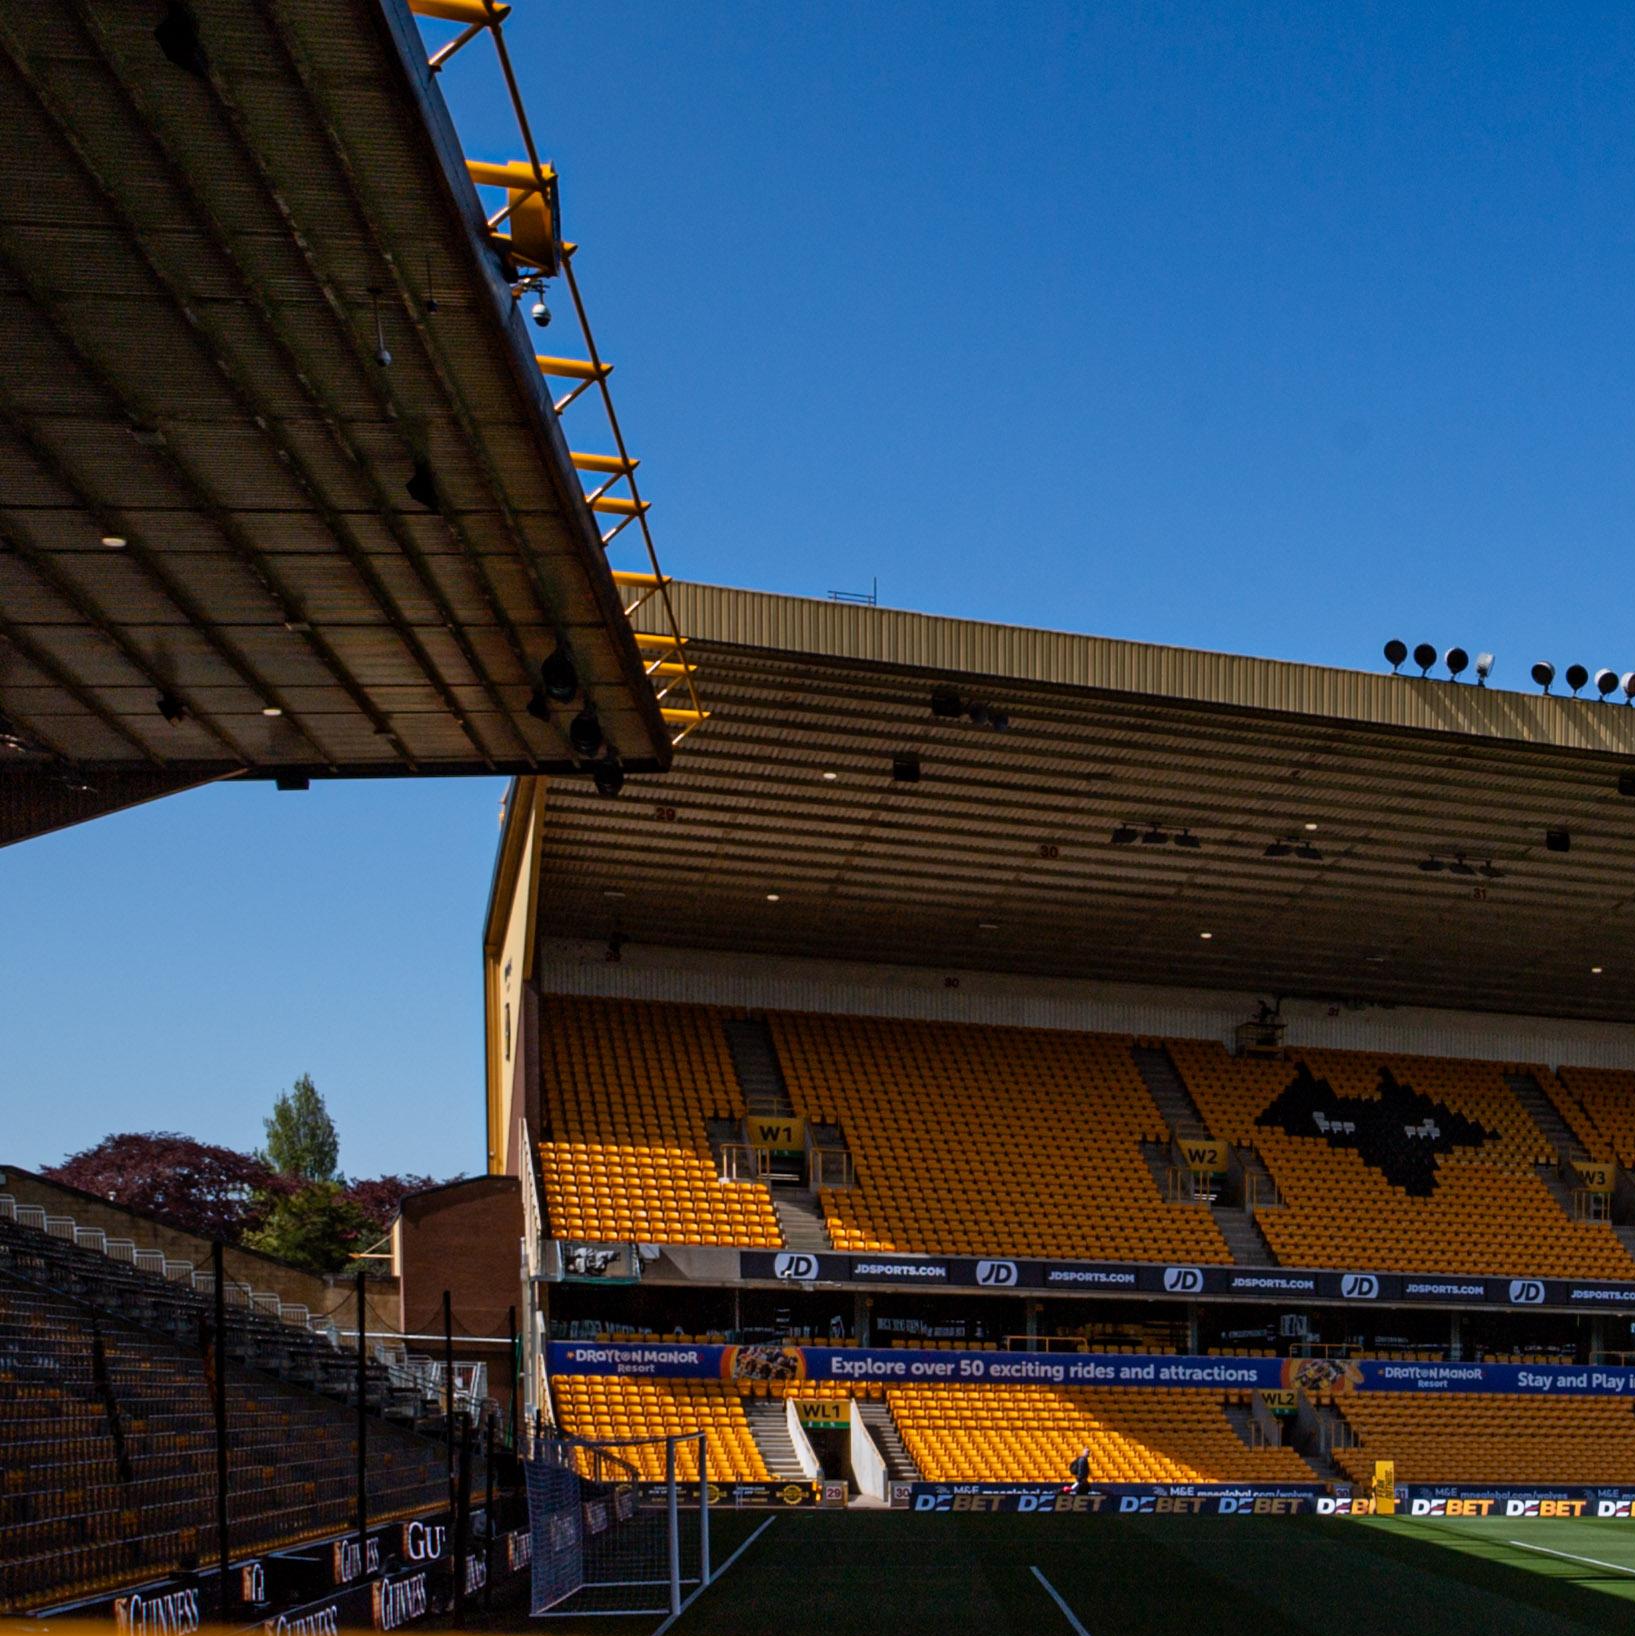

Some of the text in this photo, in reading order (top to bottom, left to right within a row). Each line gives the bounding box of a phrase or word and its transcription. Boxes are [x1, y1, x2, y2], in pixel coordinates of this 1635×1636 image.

[656, 807, 676, 821] 29
[1040, 845, 1058, 859] 30
[1473, 887, 1486, 900] 31
[764, 1126, 793, 1143] W1
[1188, 1149, 1218, 1165] W2
[1582, 1171, 1605, 1185] W3
[780, 1256, 812, 1276] JD
[854, 1265, 947, 1277] JDSPORTS.COM
[985, 1264, 1013, 1284] JD
[1048, 1270, 1136, 1284] JDSPORTS.COM
[1169, 1270, 1198, 1290] JD
[1231, 1277, 1314, 1290] JDSPORTS.COM
[1347, 1278, 1374, 1296] JD
[1406, 1284, 1484, 1296] JDSPORTS.COM
[1514, 1282, 1541, 1301] JD
[618, 1365, 656, 1374] Resort
[831, 1357, 1257, 1382] Explore over 50 exciting rides and attractions
[1418, 1379, 1448, 1388] Resort
[1518, 1371, 1552, 1389] Stay
[1557, 1373, 1587, 1388] and
[1592, 1373, 1625, 1391] Play
[1262, 1392, 1295, 1406] WL2
[803, 1404, 841, 1418] WL1
[826, 1487, 841, 1498] 29
[896, 1487, 910, 1498] 30
[1170, 1486, 1194, 1497] M&E
[1434, 1487, 1458, 1497] M&E
[1119, 1496, 1206, 1513] DEBET
[1217, 1497, 1303, 1514] DEBET
[1411, 1499, 1494, 1516] DEBET
[1506, 1500, 1588, 1517] DEBET
[381, 1572, 427, 1632] GUINNESS
